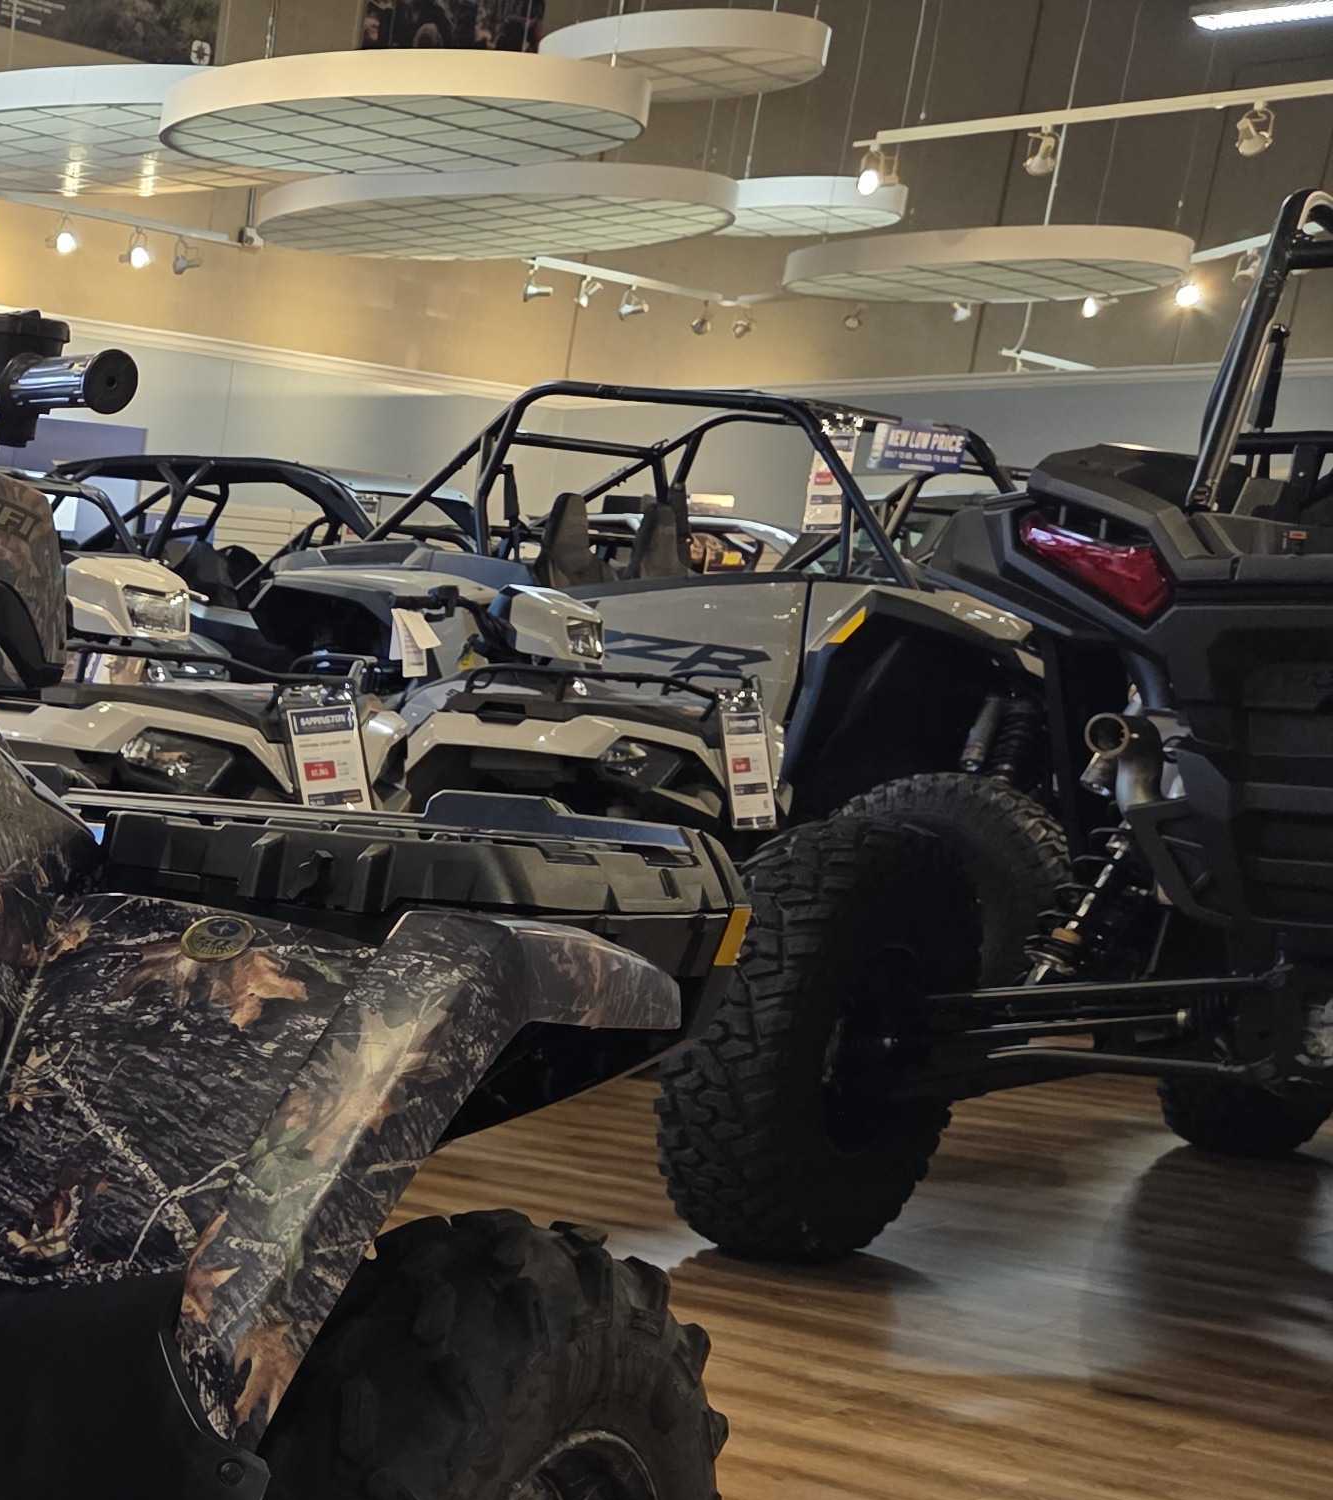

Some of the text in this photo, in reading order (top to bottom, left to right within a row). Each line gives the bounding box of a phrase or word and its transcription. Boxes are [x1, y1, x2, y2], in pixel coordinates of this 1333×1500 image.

[888, 429, 966, 453] NEW LOW PRICE
